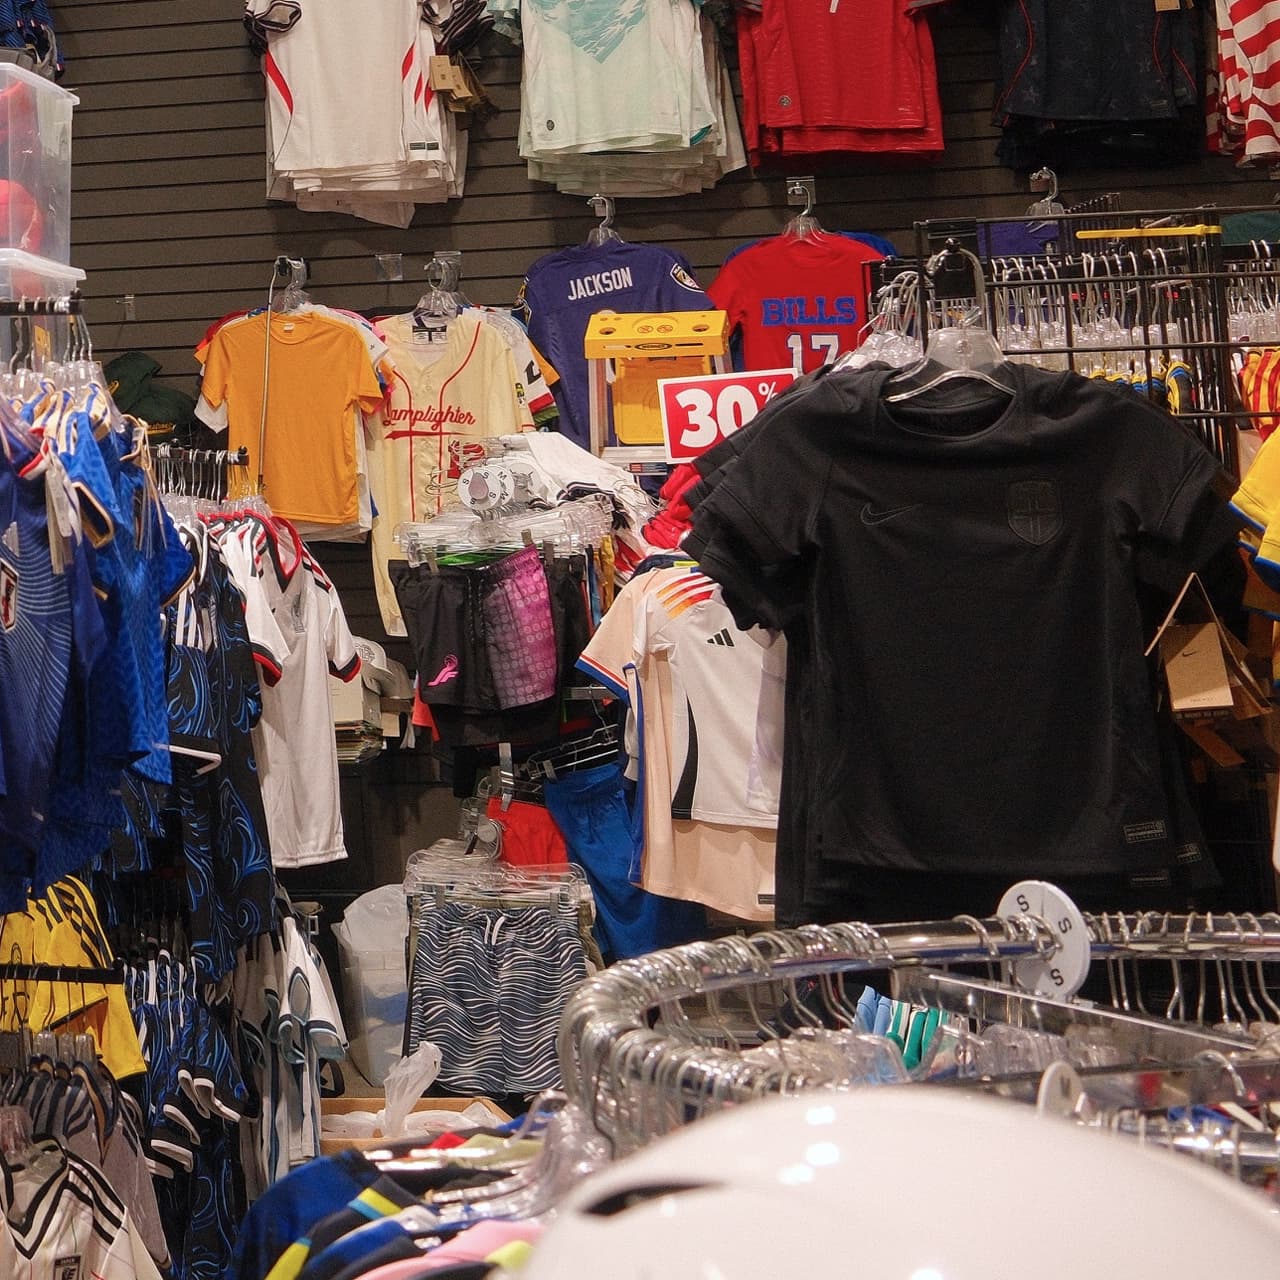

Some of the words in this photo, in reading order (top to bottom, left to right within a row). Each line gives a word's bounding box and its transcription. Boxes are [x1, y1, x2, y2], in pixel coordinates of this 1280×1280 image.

[567, 266, 633, 301] JACKSON
[761, 295, 858, 327] BILLS
[786, 331, 839, 376] 17
[1016, 893, 1031, 913] S
[1057, 917, 1073, 935] S
[1049, 968, 1065, 987] S
